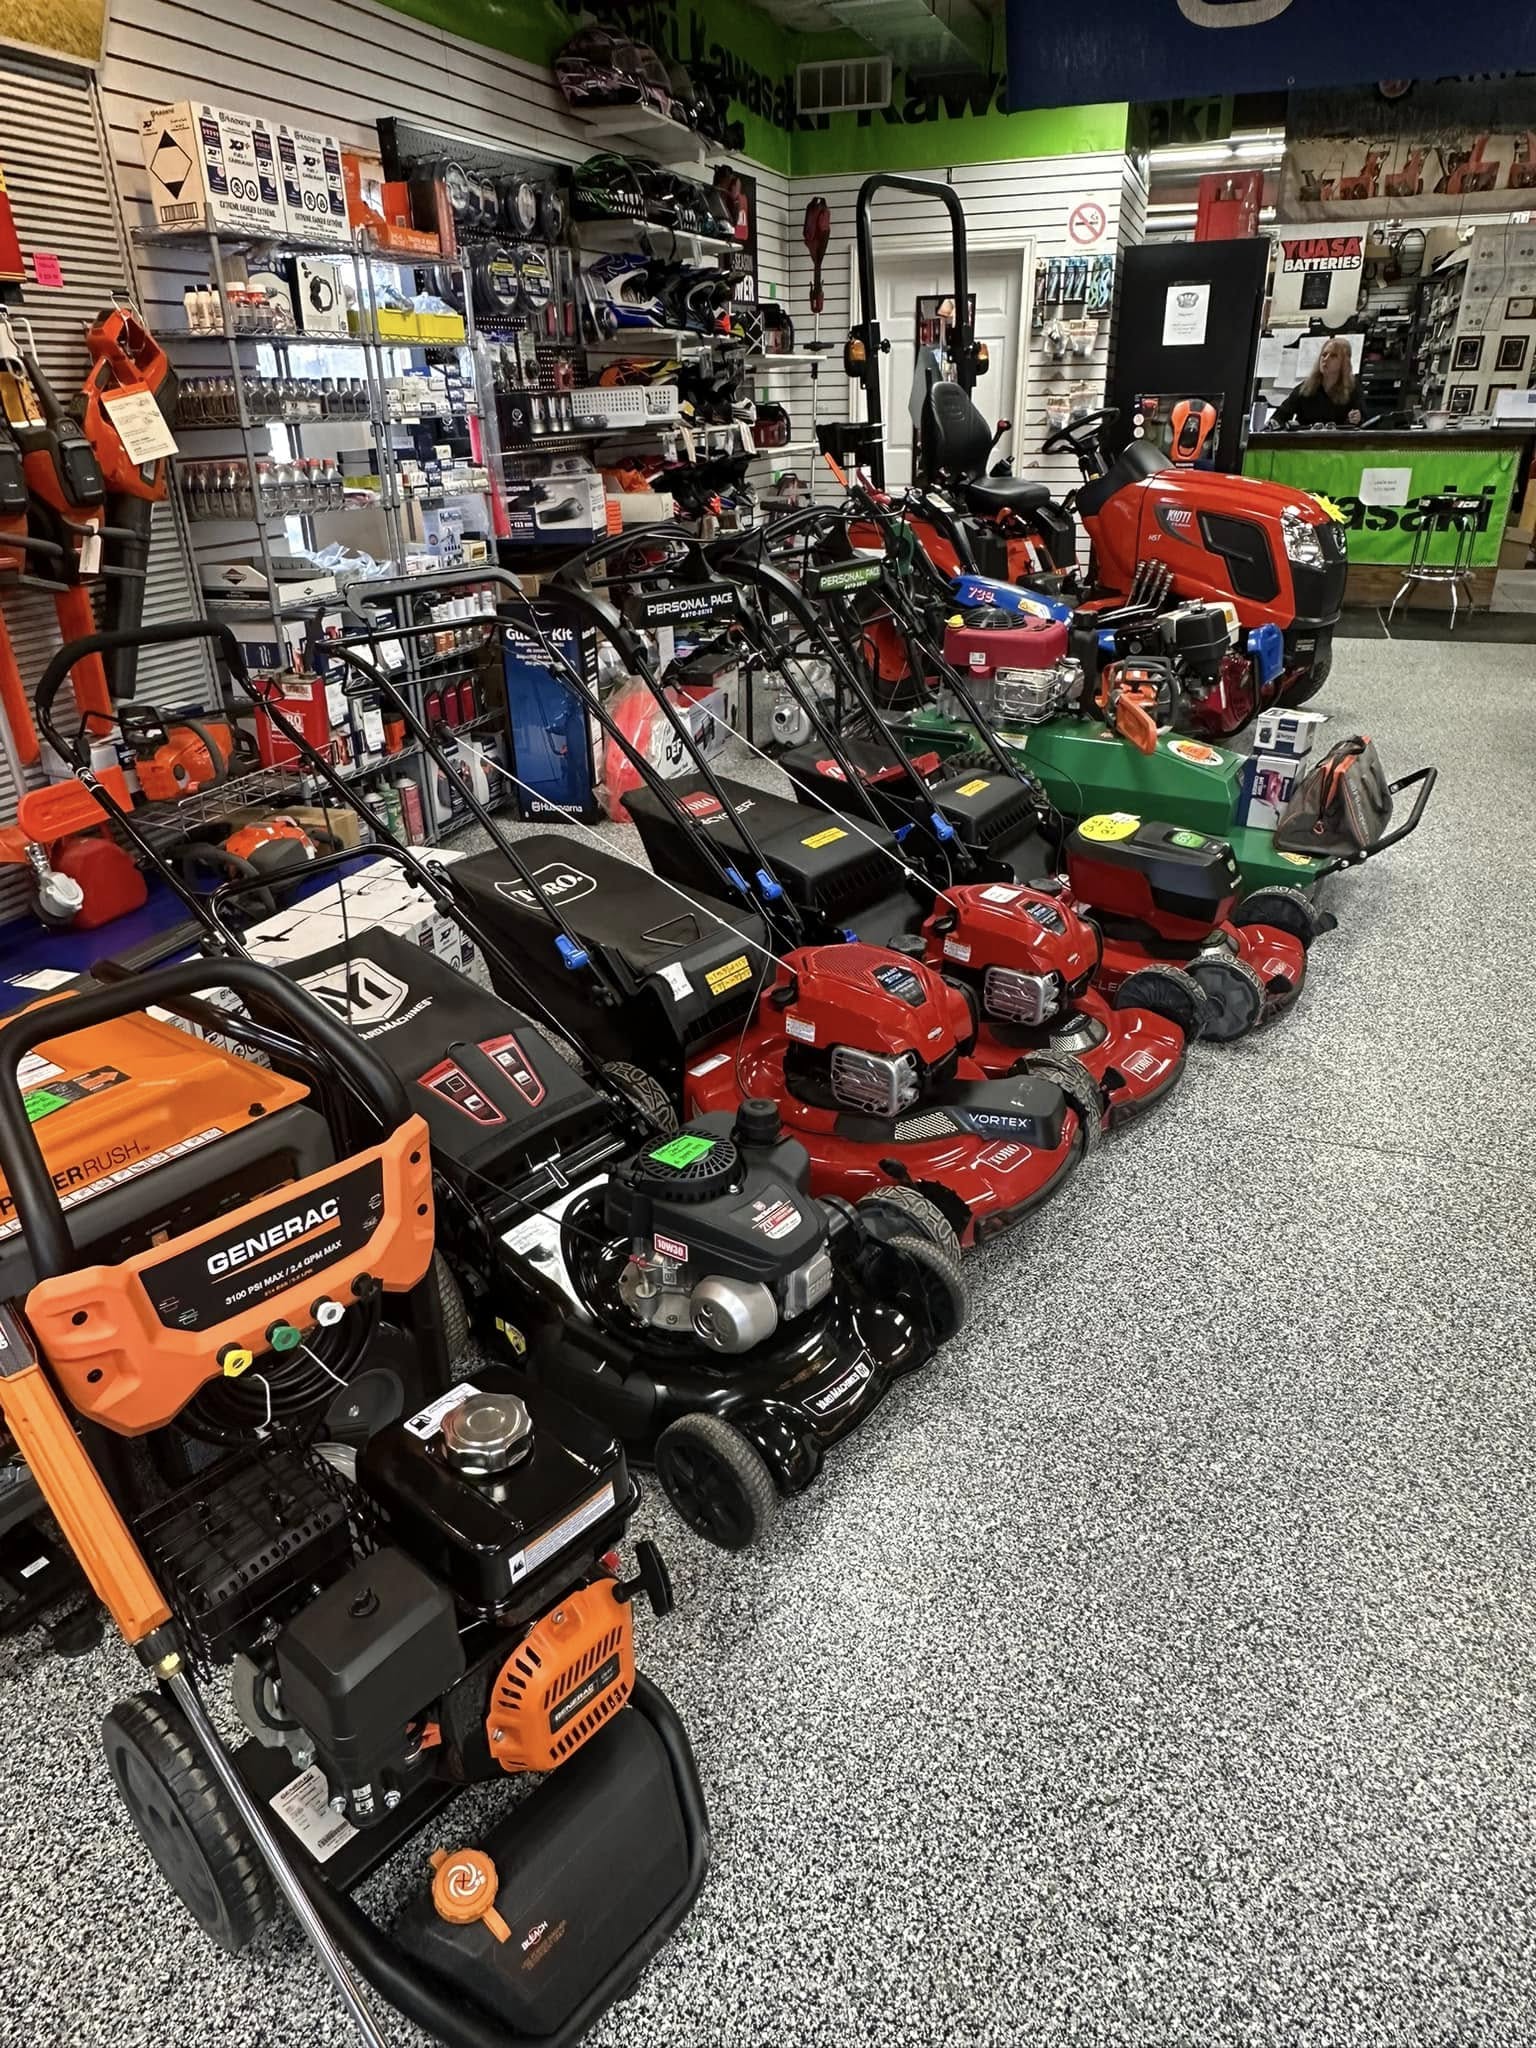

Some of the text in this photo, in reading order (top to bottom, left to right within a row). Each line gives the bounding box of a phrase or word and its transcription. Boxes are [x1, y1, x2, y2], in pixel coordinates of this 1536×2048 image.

[1282, 238, 1361, 258] YUASA
[1284, 256, 1361, 272] BATTERIES
[1166, 509, 1193, 524] KIOTI
[820, 565, 881, 587] PERSONAL PACE
[647, 592, 734, 616] PERSONAL PACE
[551, 628, 574, 641] Kit
[1130, 1055, 1154, 1075] TORO
[968, 1113, 1027, 1128] VORTEX
[987, 1143, 1020, 1165] TORO
[0, 1141, 143, 1216] PERRUSH
[206, 1198, 339, 1276] GENERAC
[656, 1239, 684, 1258] 10W30
[225, 1289, 247, 1305] 3100
[247, 1281, 263, 1295] PSI
[264, 1271, 285, 1289] MAX
[290, 1261, 303, 1275] 2.4
[303, 1251, 323, 1267] GPM
[323, 1239, 342, 1255] MAX
[521, 1920, 549, 1951] BLEACH
